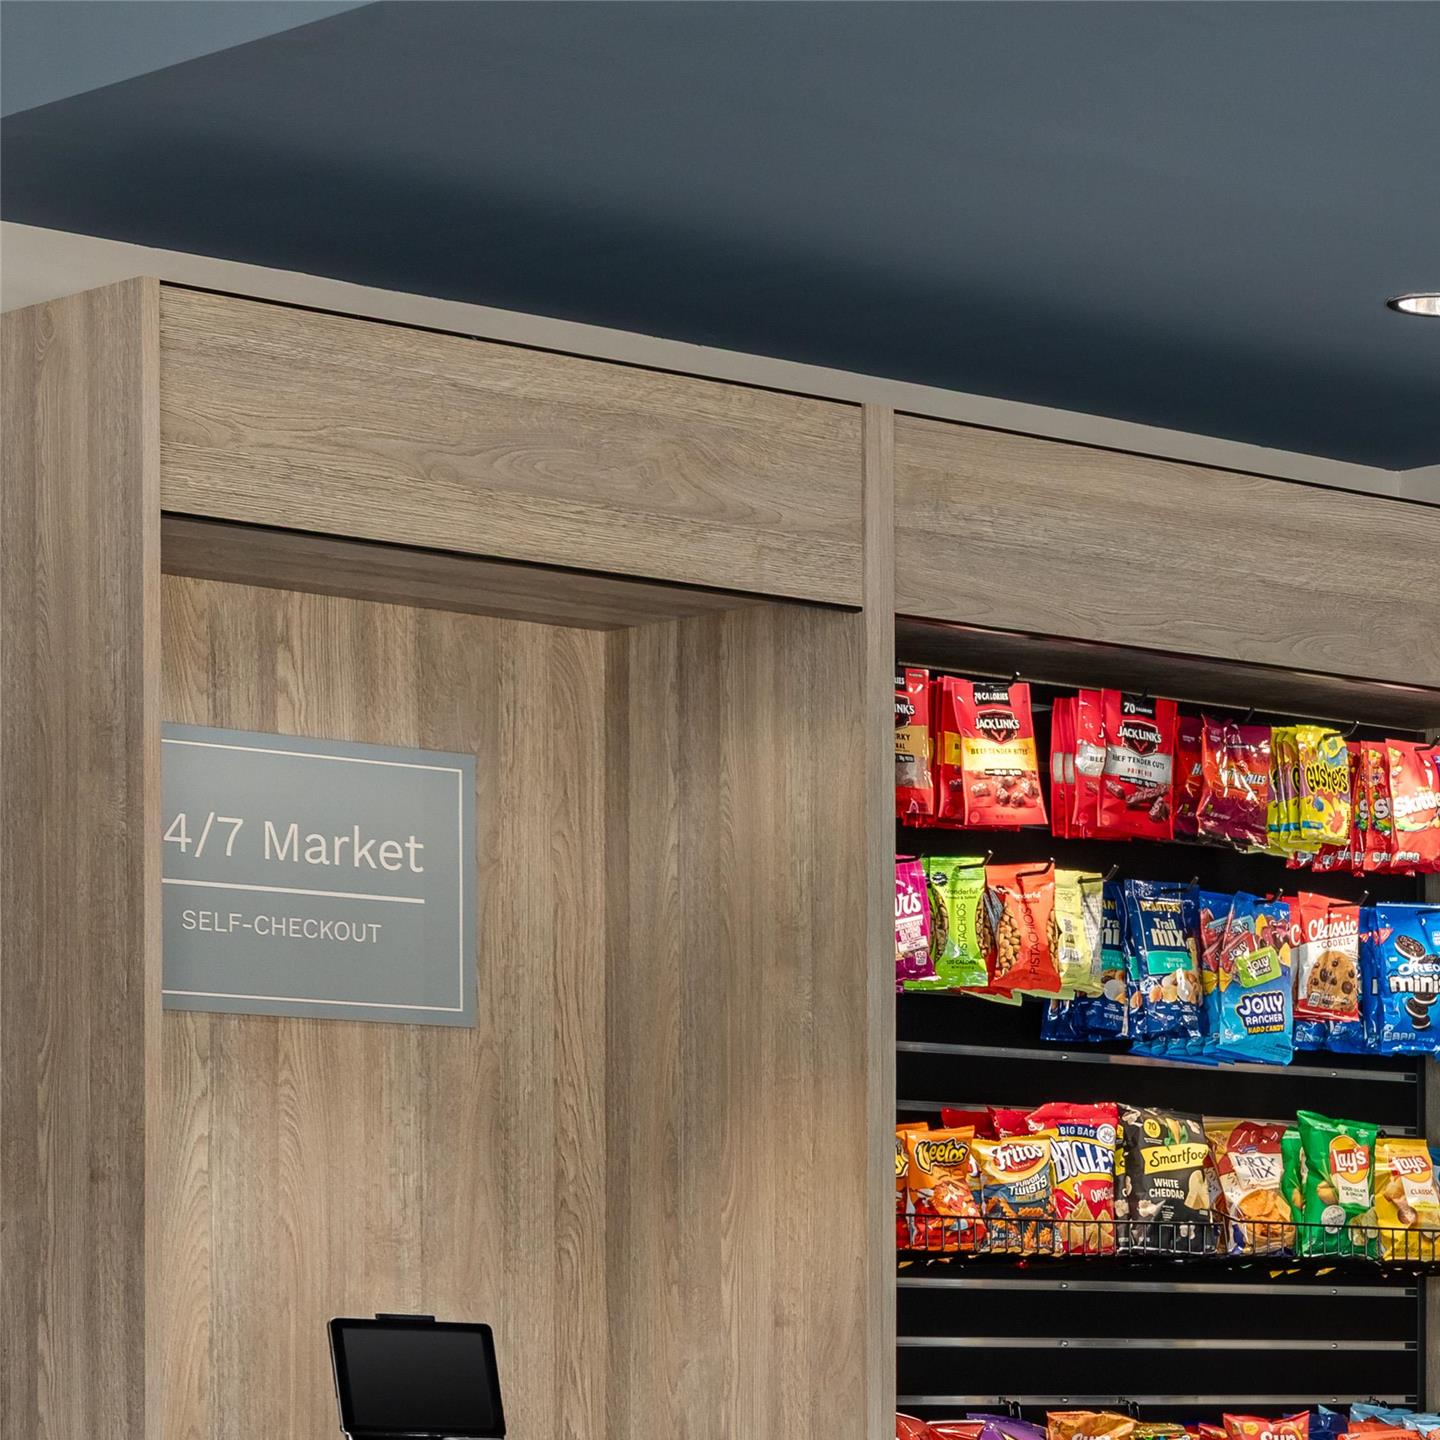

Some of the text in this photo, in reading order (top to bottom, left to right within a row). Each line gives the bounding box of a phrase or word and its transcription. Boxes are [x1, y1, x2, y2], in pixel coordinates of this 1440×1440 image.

[982, 692, 1008, 700] CALORIES
[1123, 702, 1135, 714] 70
[1128, 757, 1165, 769] TENDER CUTS
[263, 820, 424, 873] Market
[182, 910, 382, 944] SELF-CHECKOUT
[1153, 917, 1175, 929] Trail
[1308, 916, 1358, 941] Classic
[956, 903, 968, 957] PISTACHIOS
[1023, 906, 1040, 975] PISTACHIOS
[1151, 929, 1185, 946] mix
[1321, 939, 1351, 949] COOKIE
[1240, 994, 1284, 1015] JOLLY
[1245, 1012, 1283, 1024] RANCHER
[1266, 1024, 1284, 1033] CANDY
[1060, 1126, 1095, 1137] BIG BAG
[1148, 1123, 1157, 1131] 70
[1334, 1149, 1368, 1173] Lay's
[1008, 1176, 1048, 1196] TWISTS
[1154, 1178, 1179, 1187] WHITE
[1149, 1187, 1185, 1199] CHEDDAR
[1411, 1188, 1433, 1196] CLASSIC
